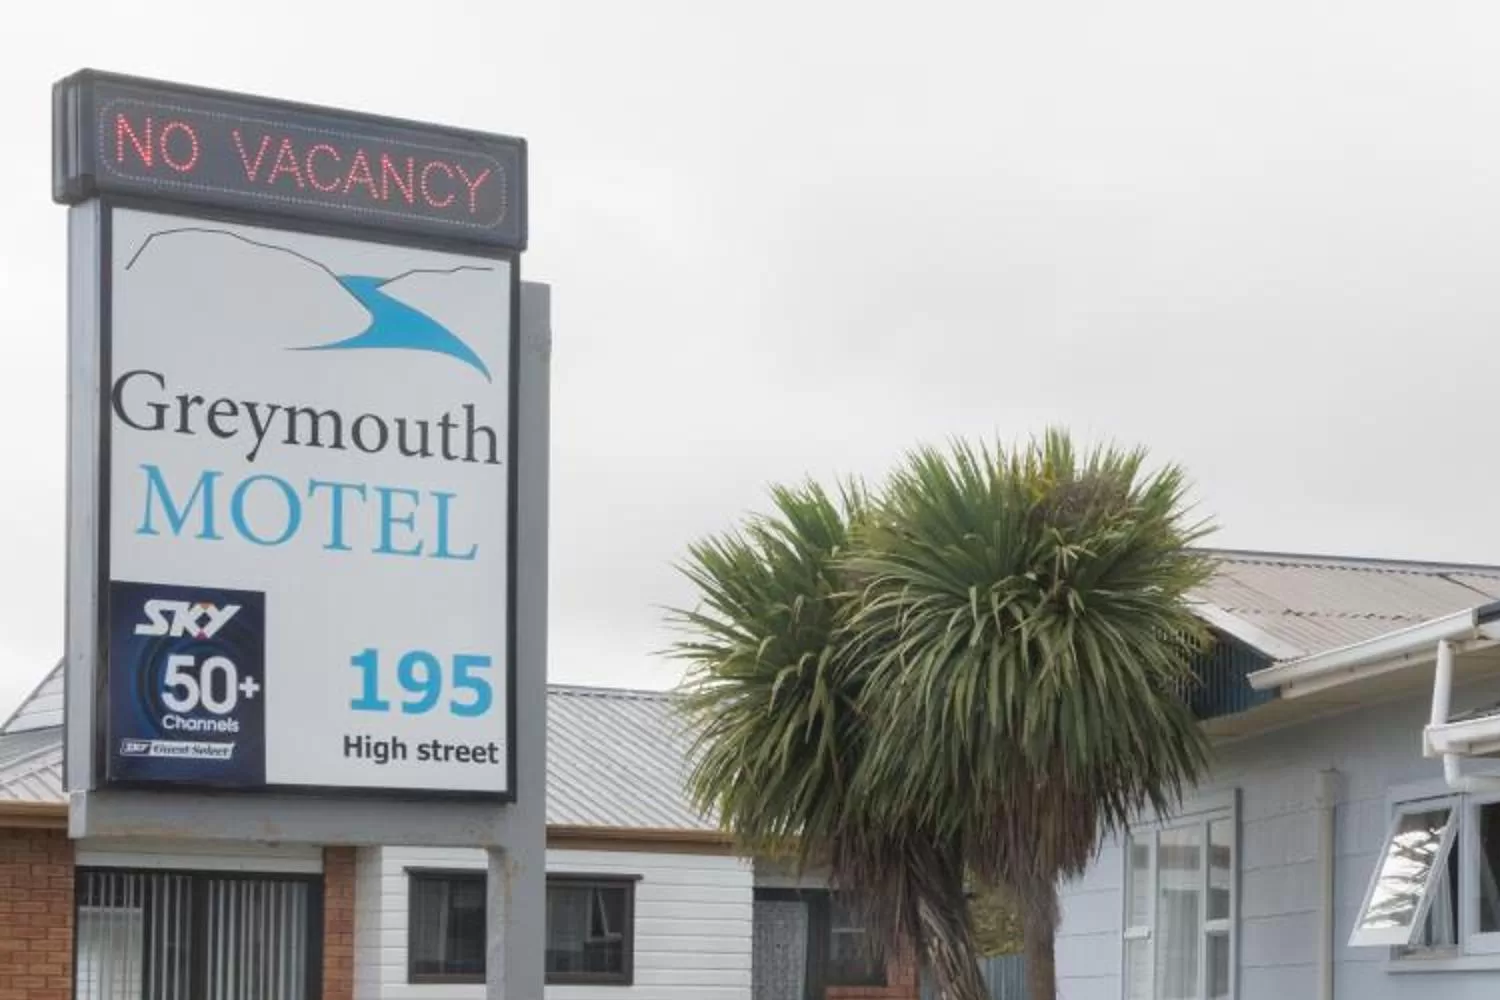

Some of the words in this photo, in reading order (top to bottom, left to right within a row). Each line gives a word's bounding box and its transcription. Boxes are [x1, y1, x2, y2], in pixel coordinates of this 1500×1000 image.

[114, 112, 199, 173] NO
[232, 128, 492, 214] VACANCY
[112, 369, 502, 465] Greymouth
[134, 463, 480, 561] MOTEL
[133, 599, 242, 640] SKY
[161, 653, 261, 715] 50+
[349, 647, 494, 718] 195
[162, 714, 240, 733] Channels
[343, 734, 408, 765] High
[416, 738, 500, 765] street
